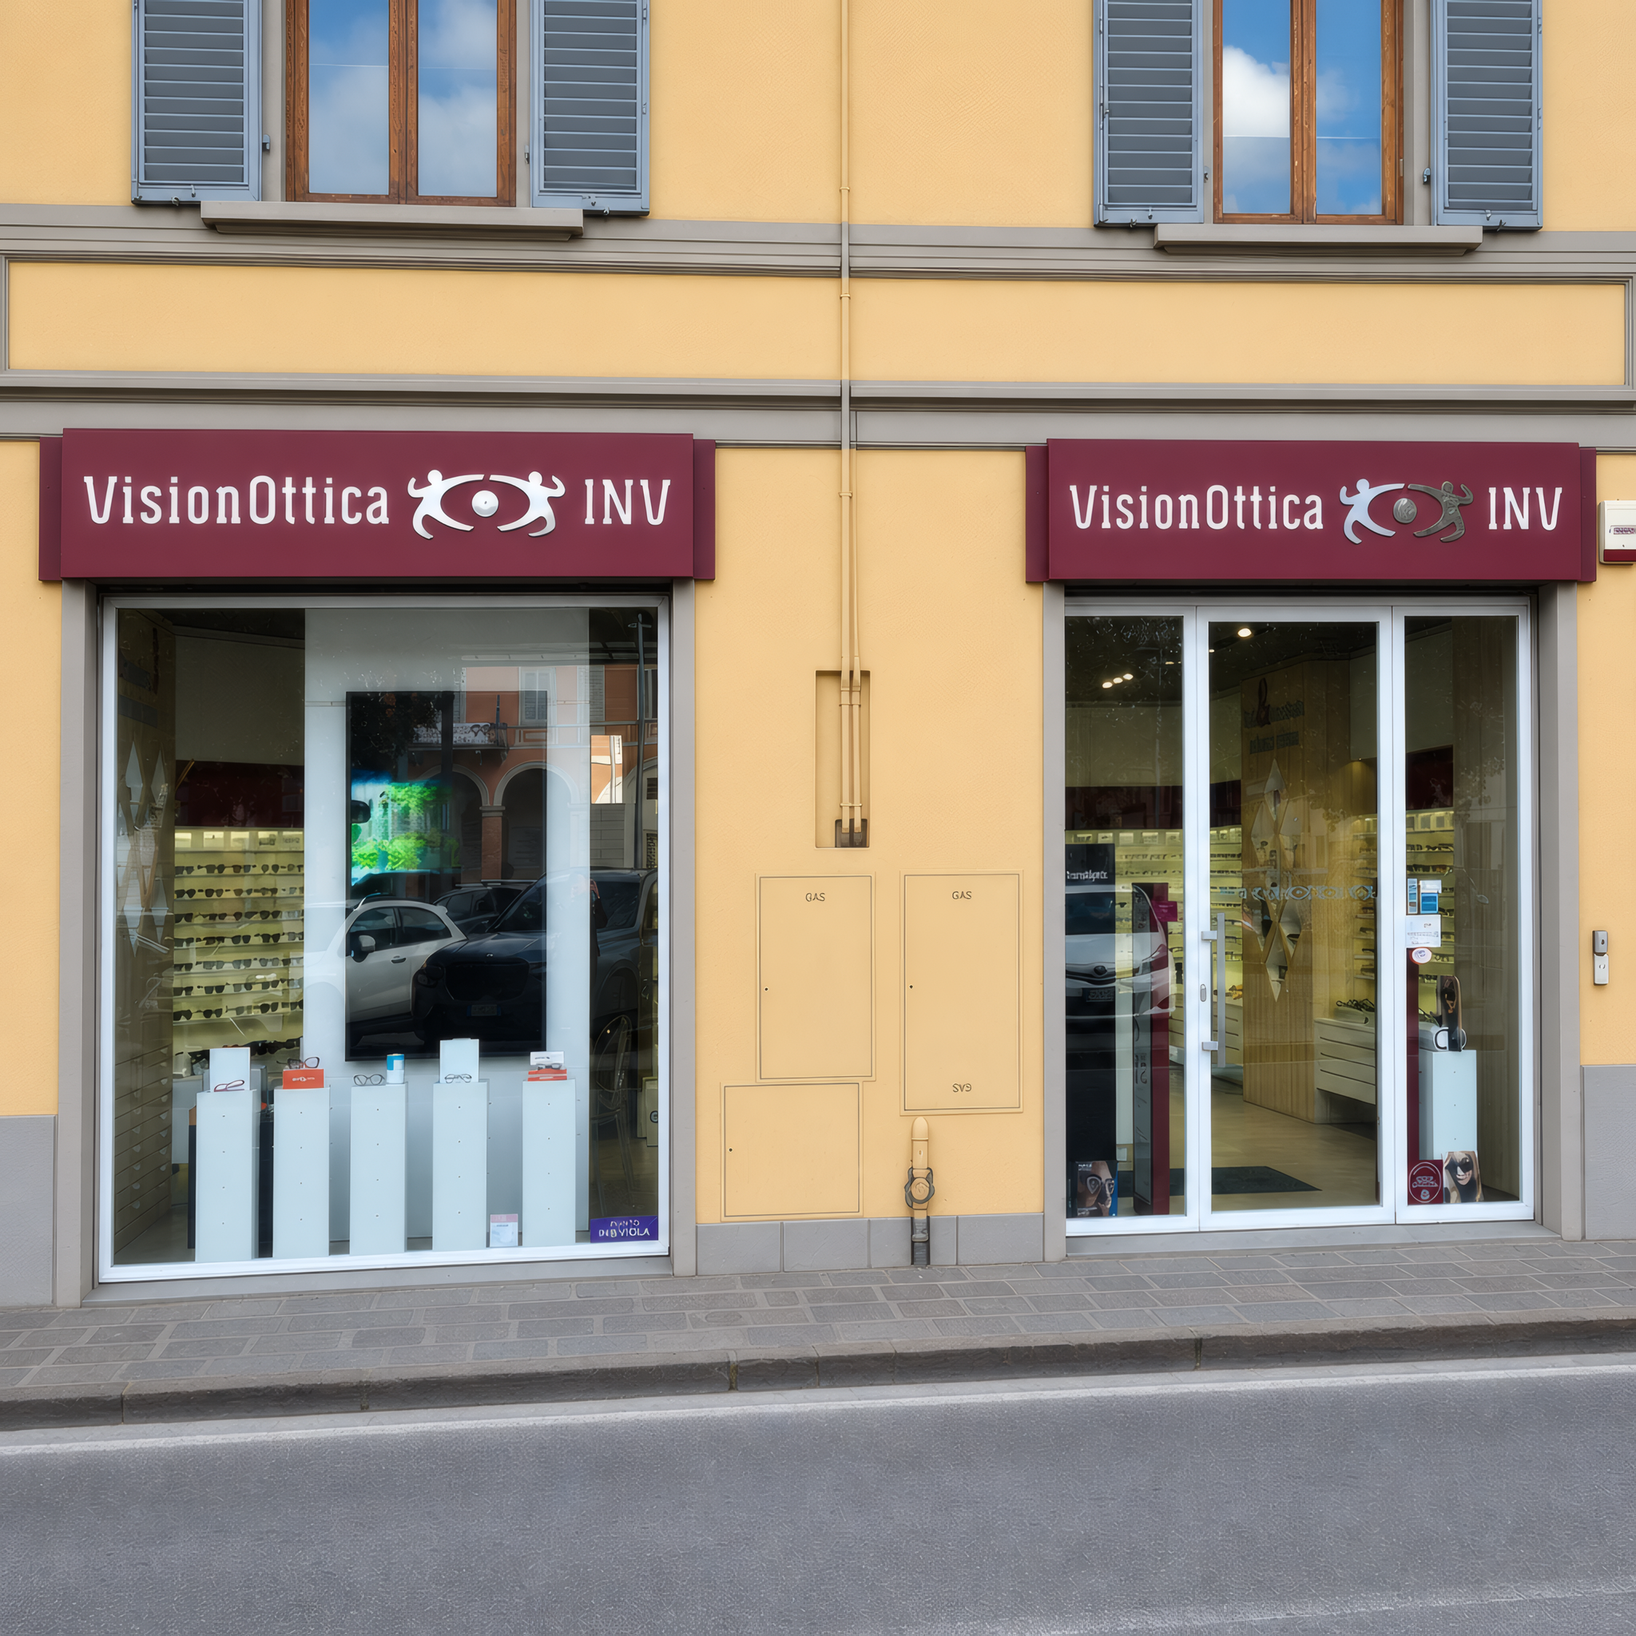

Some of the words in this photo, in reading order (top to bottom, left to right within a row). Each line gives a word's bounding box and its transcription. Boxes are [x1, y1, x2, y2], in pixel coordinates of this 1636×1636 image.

[83, 475, 390, 525] VisionOttica
[584, 478, 671, 526] INV
[1069, 484, 1324, 530] VisionOttica
[1488, 486, 1563, 531] INV
[951, 890, 973, 900] GAS
